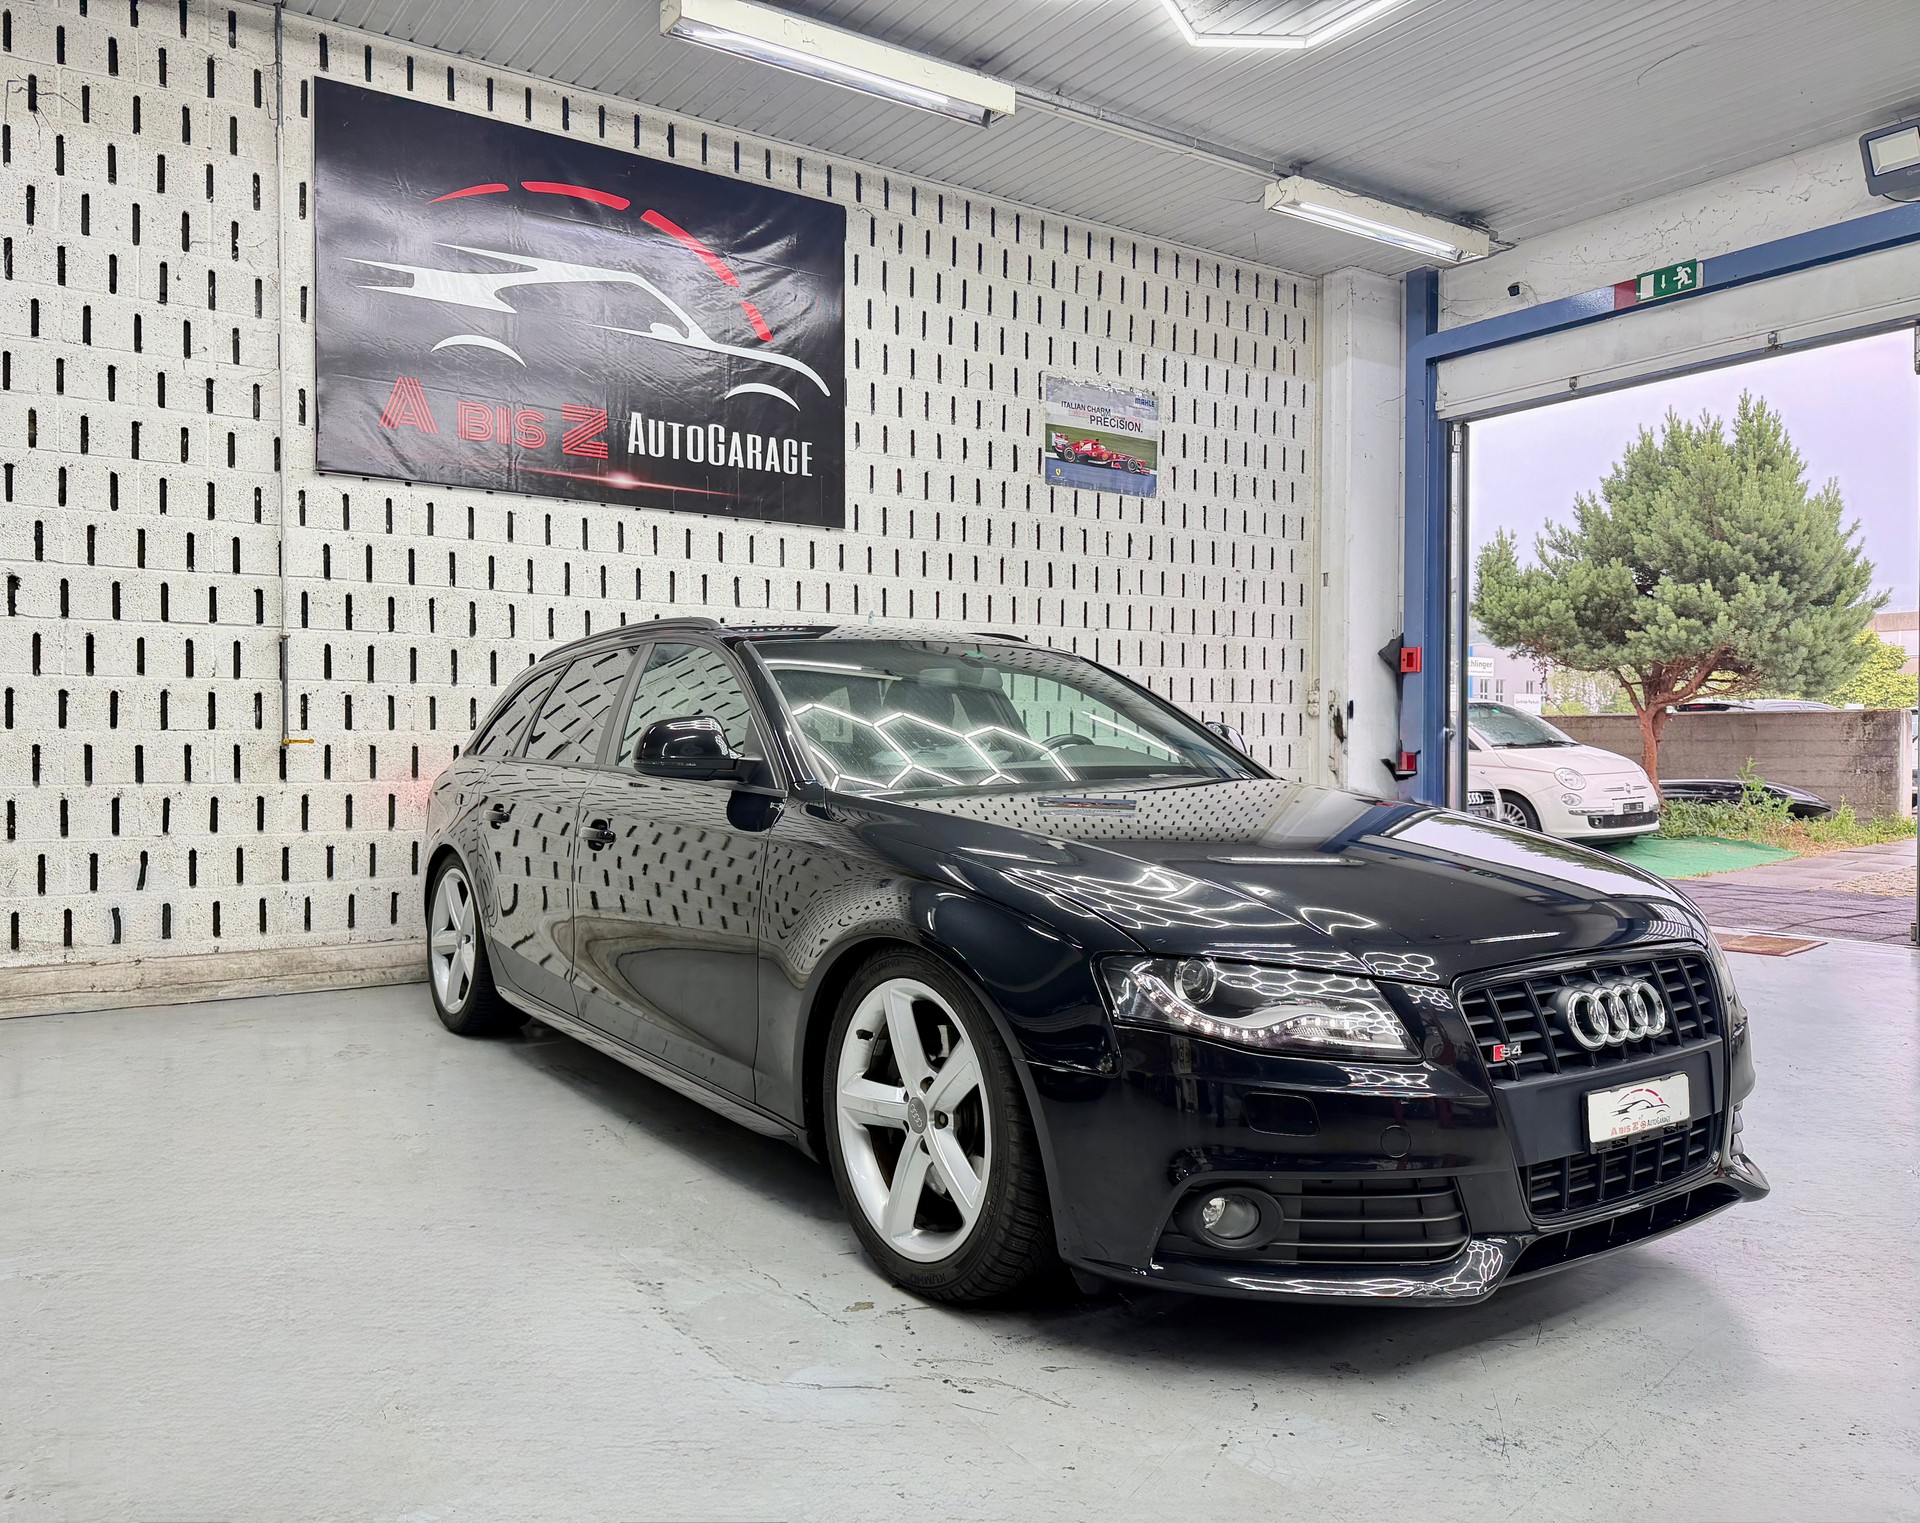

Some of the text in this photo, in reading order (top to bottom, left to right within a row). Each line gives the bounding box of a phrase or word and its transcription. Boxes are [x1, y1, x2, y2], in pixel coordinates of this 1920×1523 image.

[1061, 400, 1086, 411] ITALIAN
[378, 376, 439, 434] A
[457, 400, 547, 449] BIS
[561, 404, 609, 459] Z
[1089, 414, 1144, 433] PRECISION.
[1500, 1045, 1523, 1058] S4
[1610, 1126, 1618, 1136] A
[909, 1272, 947, 1287] KUMHO
